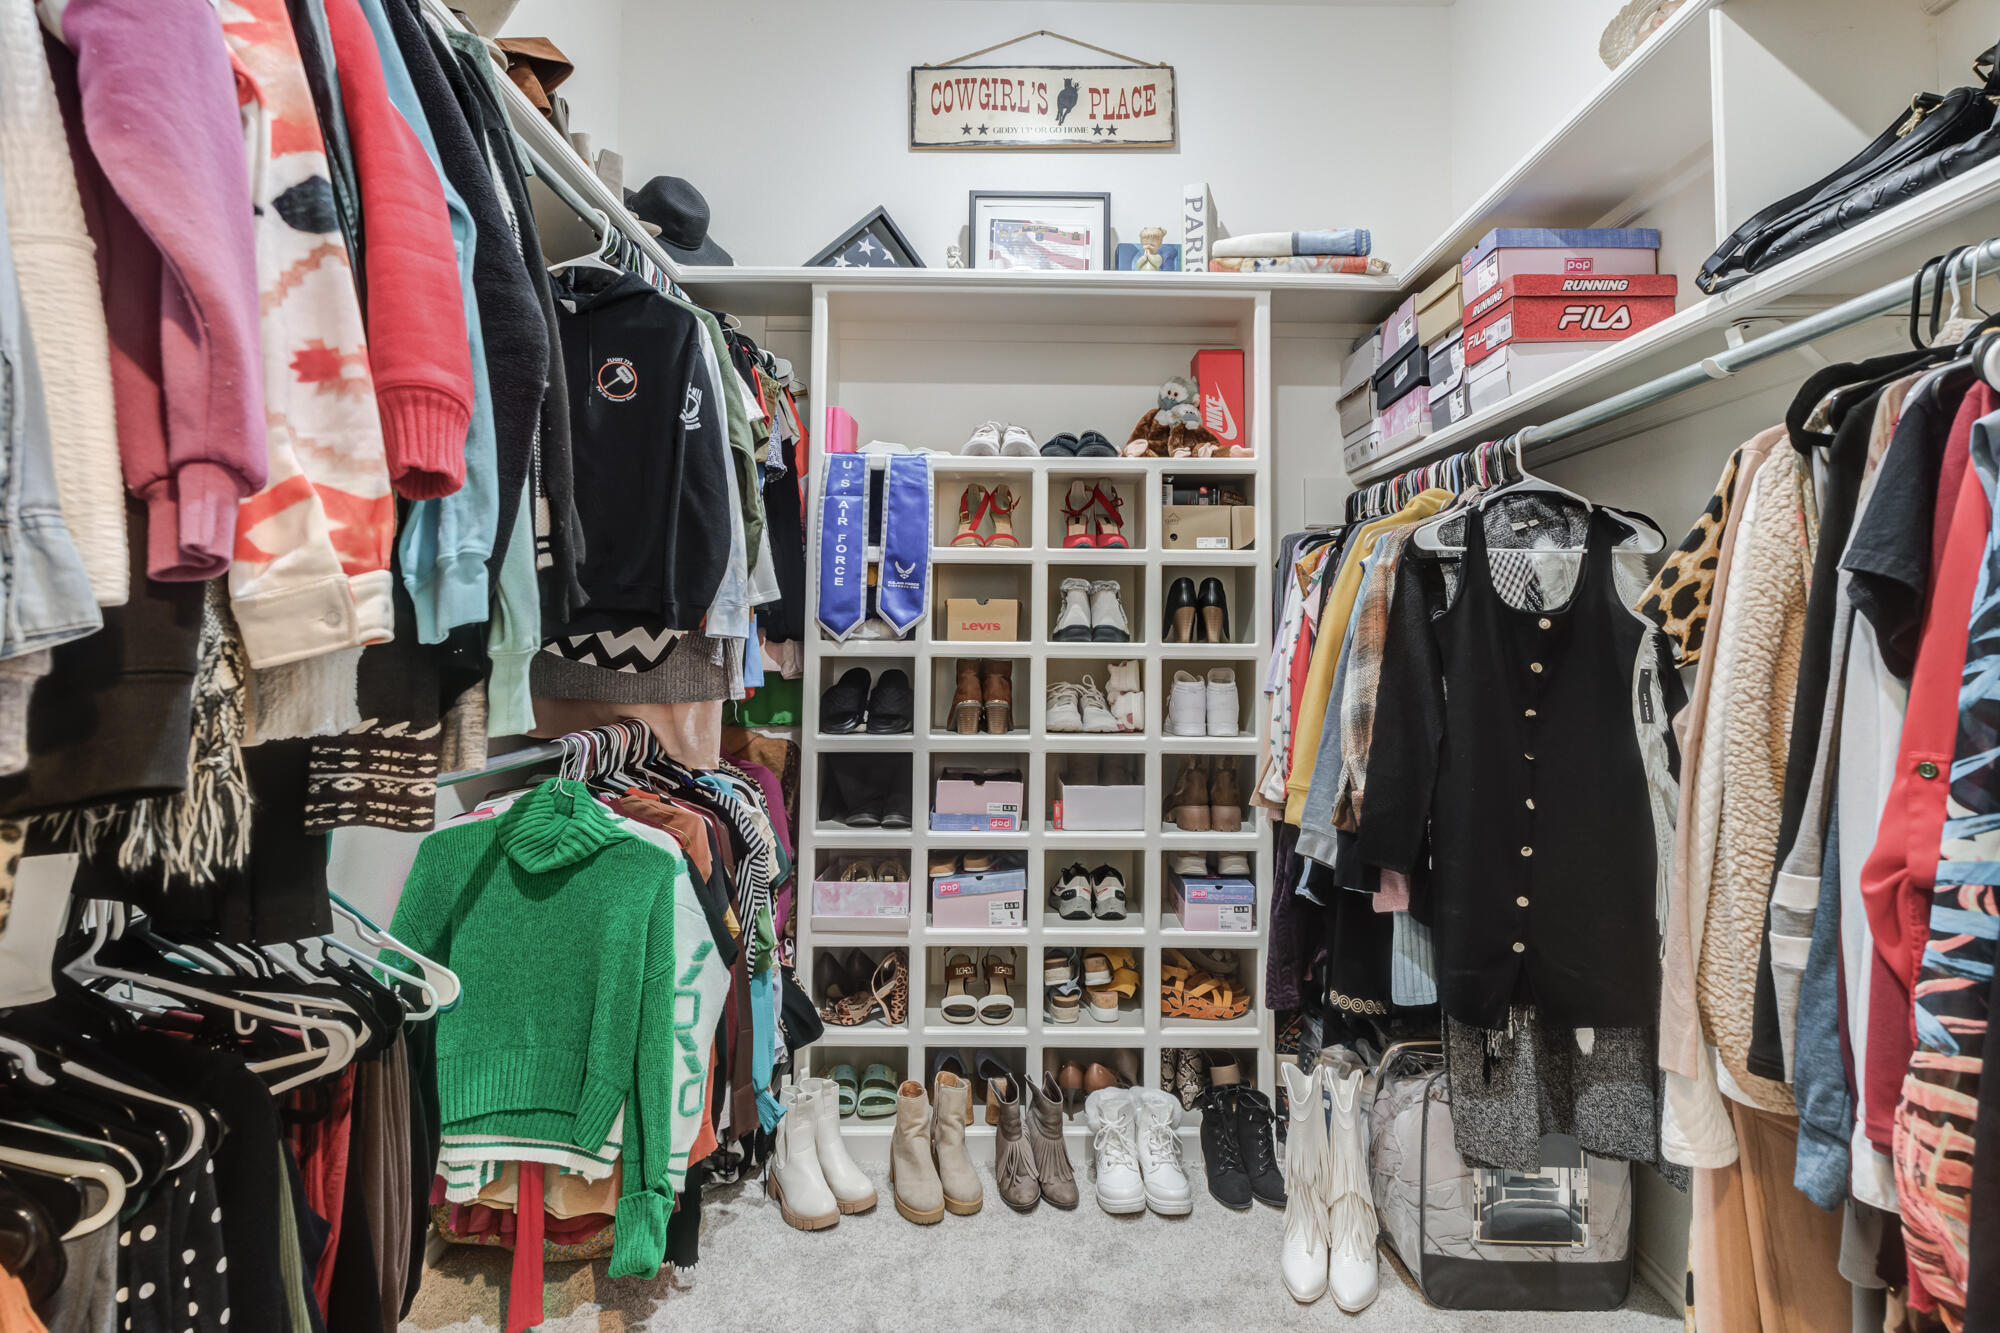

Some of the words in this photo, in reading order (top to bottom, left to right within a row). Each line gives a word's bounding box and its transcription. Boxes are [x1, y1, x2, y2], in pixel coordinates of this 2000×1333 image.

[930, 77, 1049, 116] COWGIRL'S
[1088, 83, 1157, 120] PLACE
[992, 126, 1018, 134] GIDDY
[1049, 126, 1062, 134] GO
[1064, 126, 1089, 134] HOME
[1561, 279, 1629, 291] RUNNING
[1472, 287, 1504, 319] RUNNING
[1558, 305, 1632, 330] FILA
[1466, 331, 1487, 351] FILA
[1206, 393, 1223, 432] NIKE
[834, 534, 848, 587] FORCE
